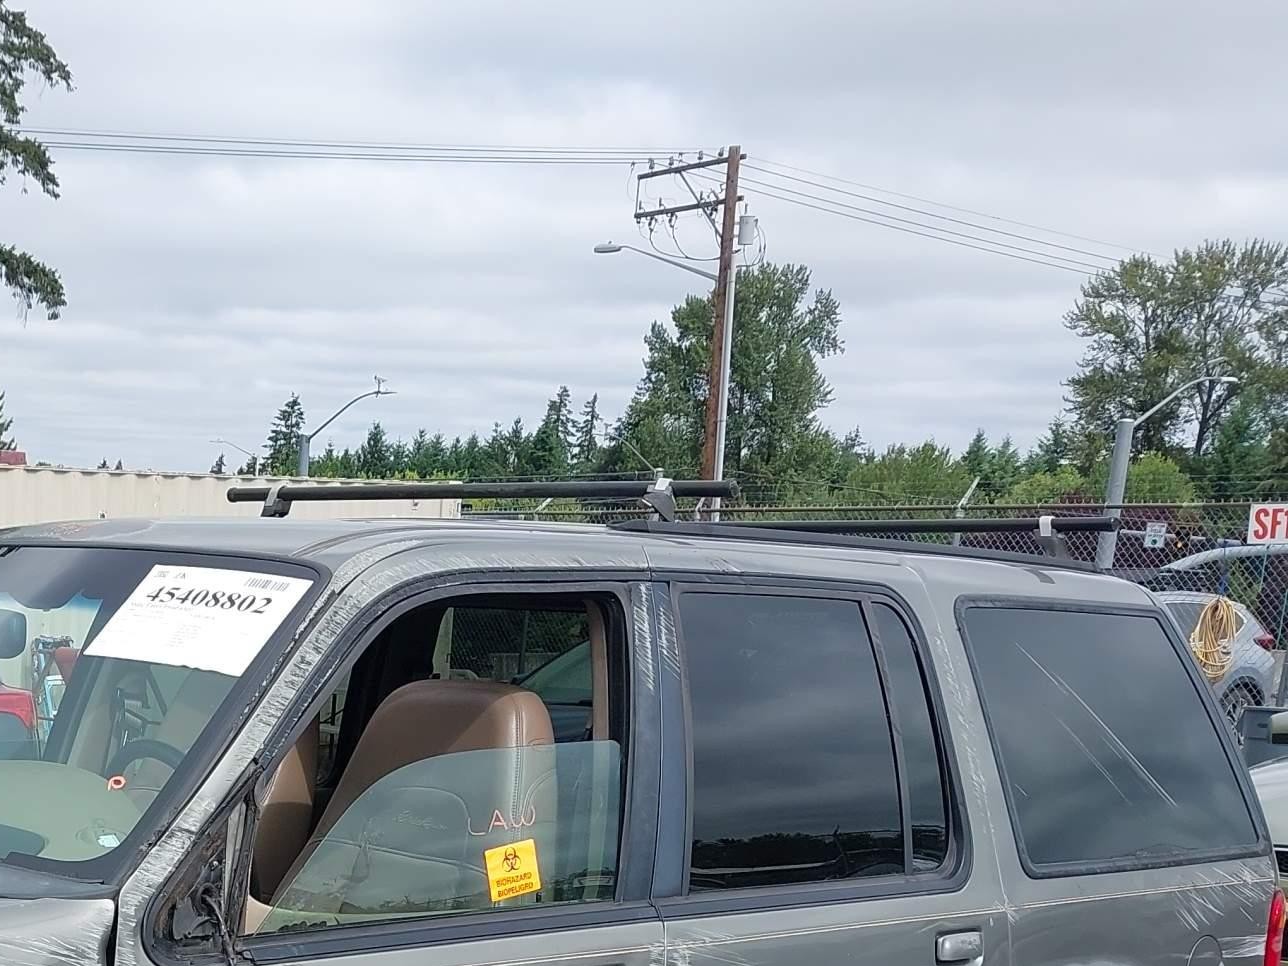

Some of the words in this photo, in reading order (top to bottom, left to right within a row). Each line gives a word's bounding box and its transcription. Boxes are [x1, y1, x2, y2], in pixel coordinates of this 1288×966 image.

[146, 585, 272, 614] 45408802
[495, 871, 532, 888] BIOHAZARD
[497, 882, 534, 898] BIOPELIGRO
